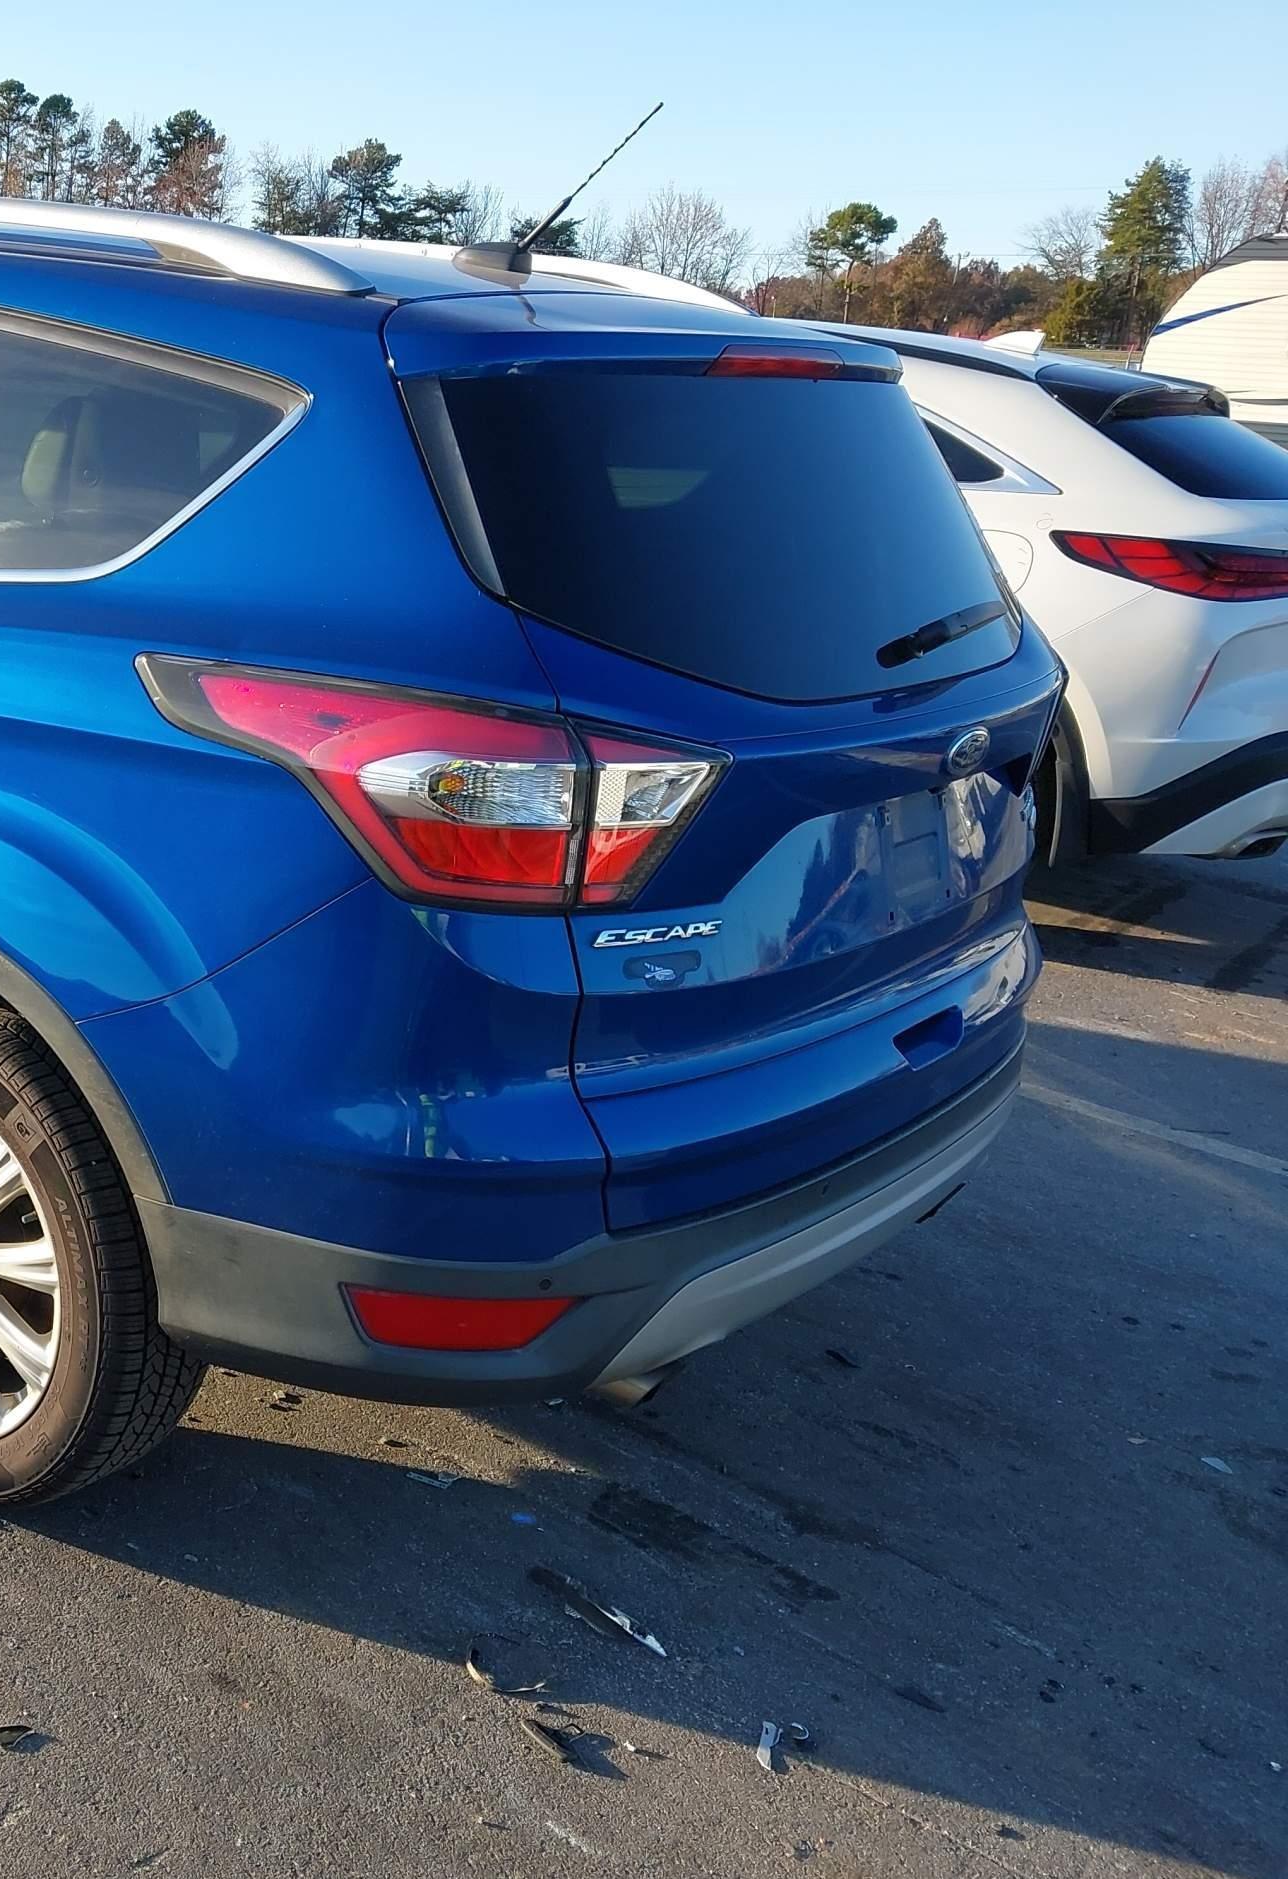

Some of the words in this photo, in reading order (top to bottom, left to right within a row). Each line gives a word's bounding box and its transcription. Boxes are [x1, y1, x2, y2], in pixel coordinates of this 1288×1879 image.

[592, 920, 723, 948] ESCAPE
[16, 1120, 31, 1138] GT
[54, 1195, 89, 1310] ALTIMAX
